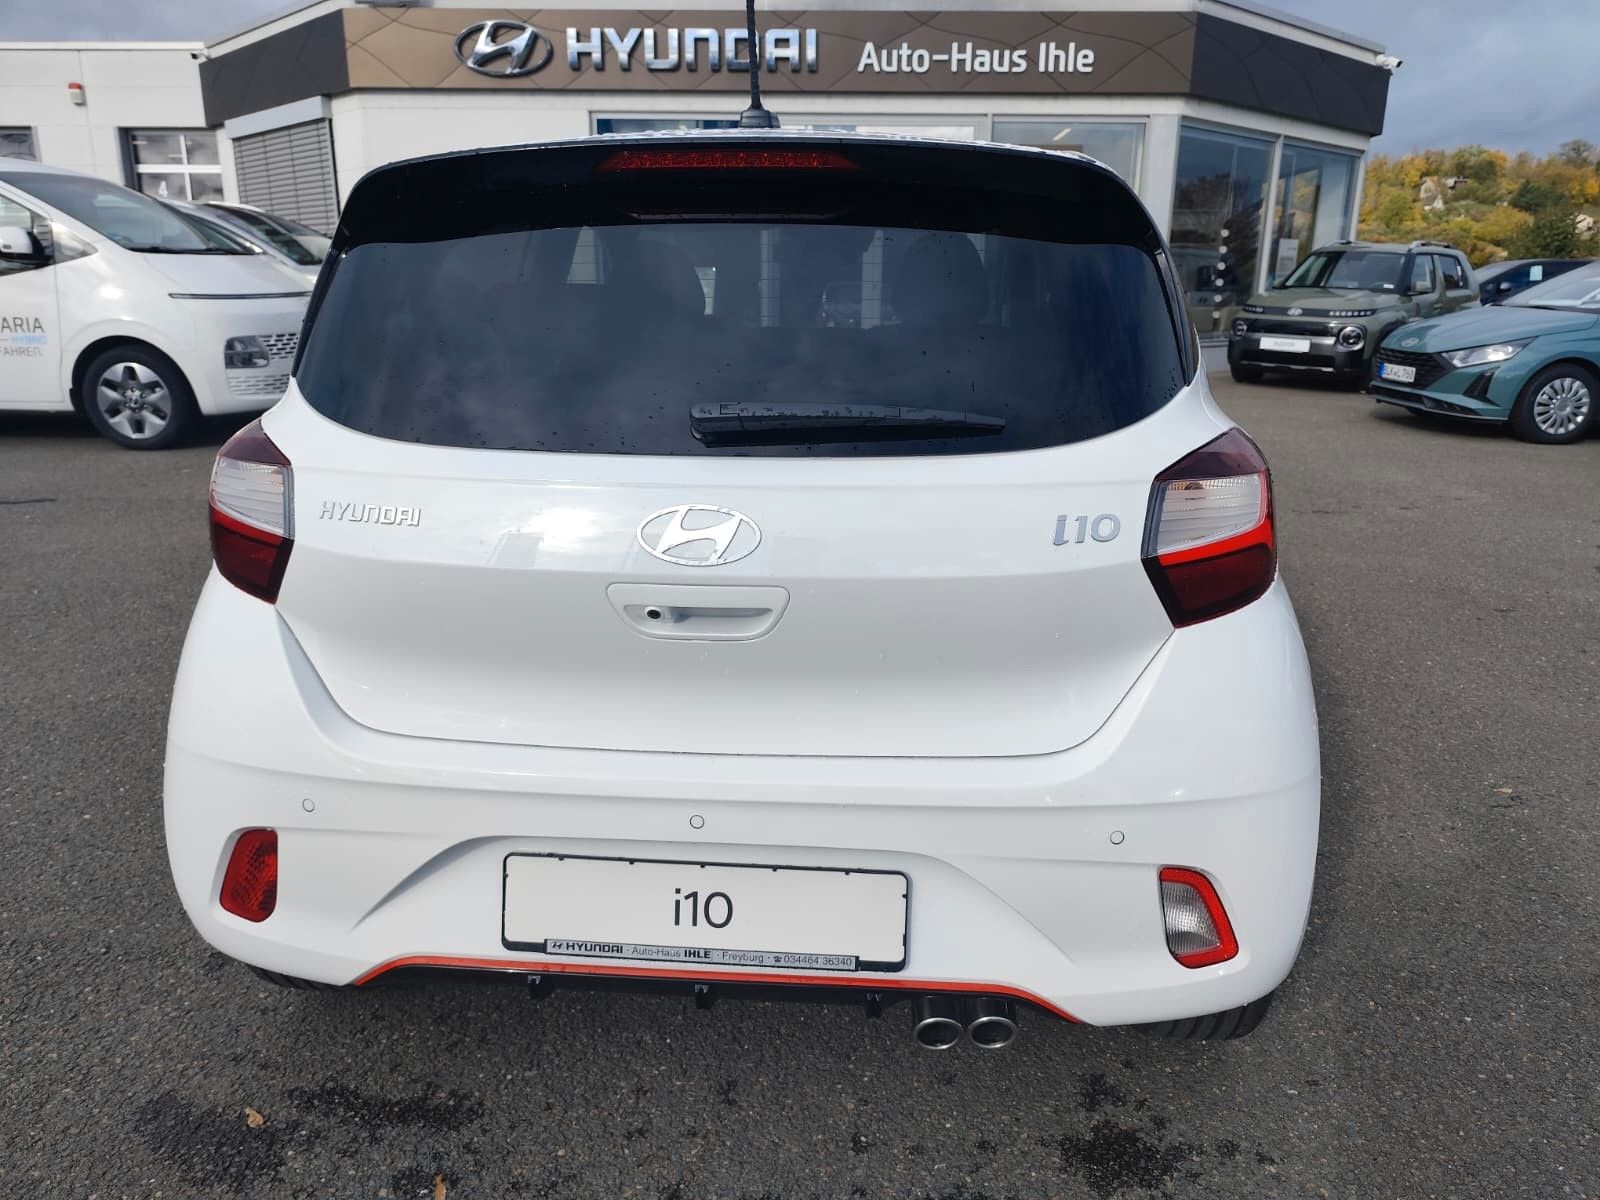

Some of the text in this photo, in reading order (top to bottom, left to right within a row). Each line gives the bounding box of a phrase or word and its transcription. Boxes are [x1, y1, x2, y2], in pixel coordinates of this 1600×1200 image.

[566, 27, 818, 74] HYUNDAI
[857, 41, 1095, 73] Auto-Haus Ihle
[319, 500, 422, 527] HYUNDAI
[1053, 513, 1121, 547] i10
[674, 887, 734, 929] i10
[566, 941, 852, 967] HYUNDAI Auto-Haus IHLE Freyburg 034464 36340
